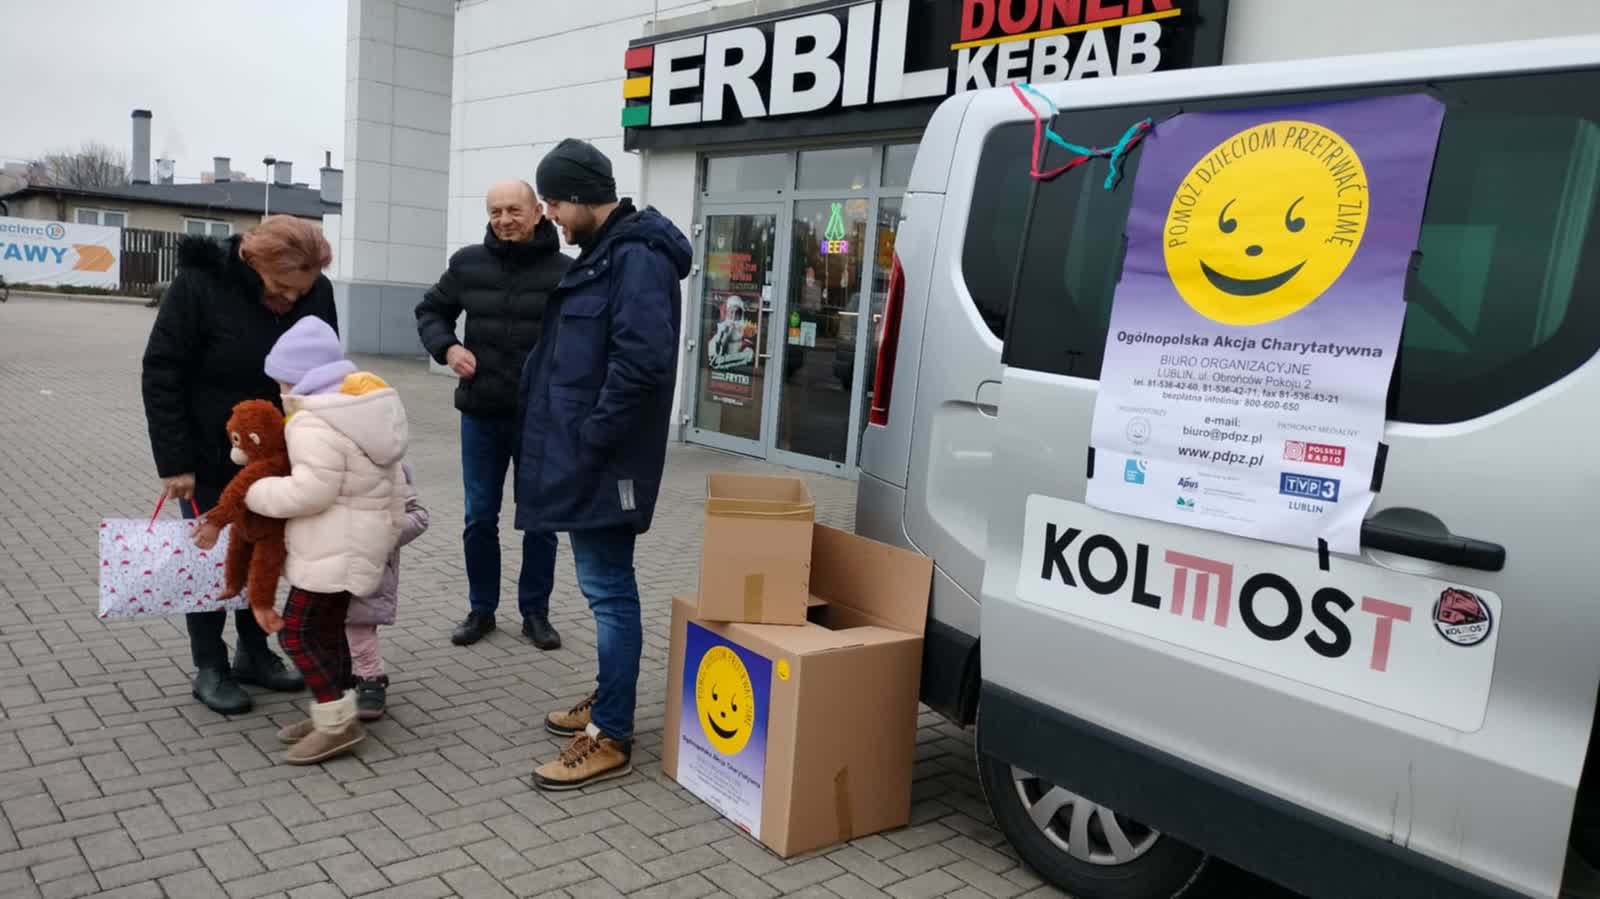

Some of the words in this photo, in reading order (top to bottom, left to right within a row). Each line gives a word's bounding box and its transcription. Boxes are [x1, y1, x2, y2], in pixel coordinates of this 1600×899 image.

[960, 0, 1173, 41] DON
[651, 0, 948, 127] ERBIL
[955, 20, 1162, 95] KEBAB
[1195, 127, 1276, 184] DZIECIOM
[1282, 126, 1367, 198] PRZETRWAĆ
[1324, 199, 1363, 248] ZIMĘ
[0, 242, 68, 264] AWY
[820, 240, 849, 256] BEER
[1117, 331, 1209, 347] Ogólnopolska
[1213, 335, 1256, 351] Akcja
[1261, 337, 1383, 358] Charytatywna
[1160, 354, 1198, 368] BIURO
[1200, 357, 1312, 376] ORGANIZACYJNE
[1265, 376, 1301, 390] Pokoju
[1304, 380, 1312, 390] 2
[1204, 416, 1241, 427] e-mail:
[1183, 425, 1264, 445] biuro@pdpz.pl
[1178, 446, 1264, 467] www.pdpz.pl
[1307, 454, 1341, 464] RADIO
[1308, 446, 1343, 456] POLSKIE
[1288, 501, 1324, 513] LUBLIN
